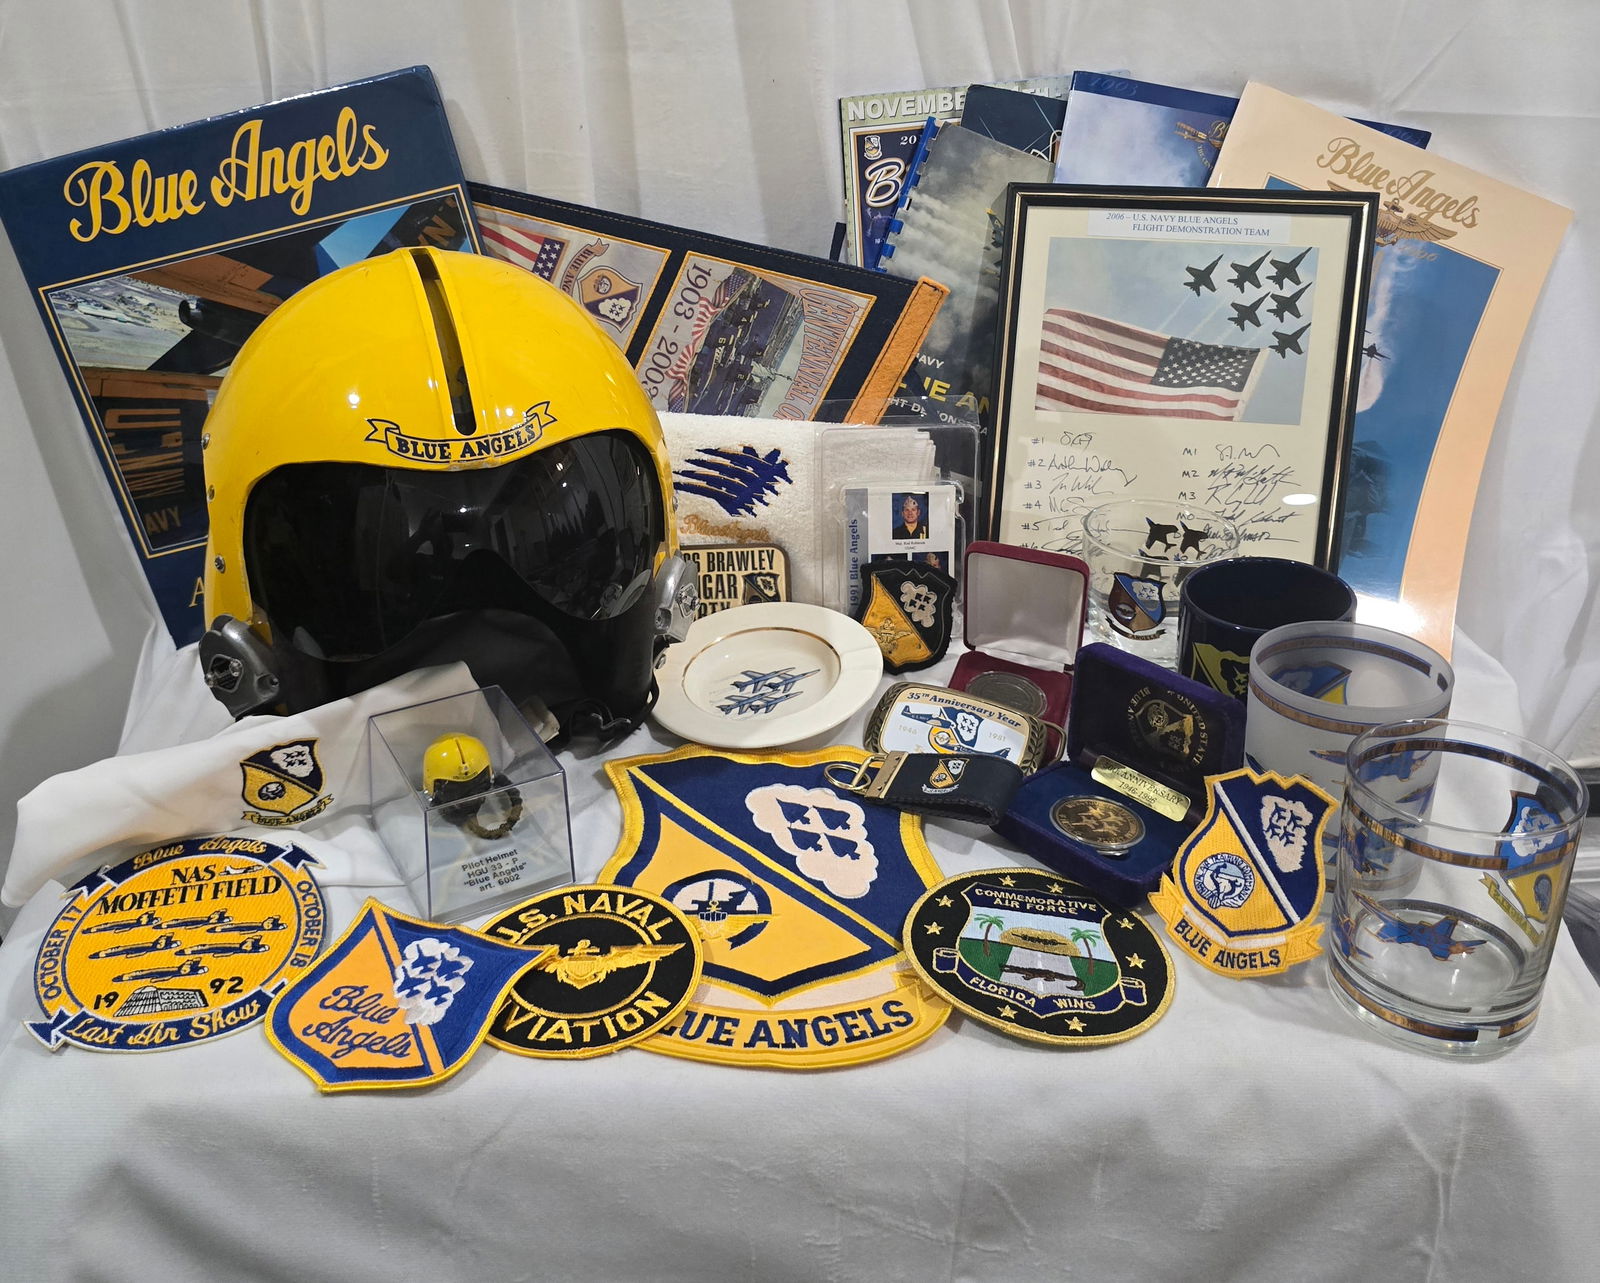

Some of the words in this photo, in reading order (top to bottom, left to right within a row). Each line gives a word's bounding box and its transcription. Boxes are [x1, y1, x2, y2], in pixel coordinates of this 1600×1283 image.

[64, 158, 206, 242] Blue
[211, 106, 389, 216] Angels
[1317, 137, 1391, 190] Blue
[1386, 170, 1480, 229] Angels
[1106, 212, 1125, 220] 2006
[1133, 213, 1148, 222] U.S.
[1150, 215, 1175, 223] NAVY
[1178, 216, 1201, 224] BLUE
[1203, 217, 1239, 225] ANGELS
[1132, 223, 1164, 232] FLIGHT
[1166, 225, 1243, 235] DEMONSTRATION
[1244, 228, 1270, 236] TEAM
[674, 263, 712, 320] 1903
[785, 288, 859, 405] CENTENNIAL
[917, 353, 945, 369] AVY
[395, 436, 452, 460] BLUE
[460, 423, 537, 458] ANGELS
[849, 519, 860, 554] Angels
[706, 549, 775, 573] BRAWLEY
[849, 556, 859, 581] Blue
[698, 573, 738, 600] GAR
[849, 585, 859, 607] 1991
[929, 694, 996, 718] Anniversary
[997, 711, 1022, 728] Year
[1119, 769, 1184, 806] ANNIVERSARY
[133, 843, 185, 870] Blue
[199, 835, 268, 854] Angels
[461, 860, 485, 872] Pilot
[485, 849, 518, 865] Helmet
[467, 867, 488, 879] HGU
[490, 862, 503, 872] 33
[511, 857, 518, 865] P
[171, 864, 217, 885] NAS
[479, 882, 495, 892] art.
[497, 873, 521, 886] 6002
[96, 883, 209, 916] MOFFETT
[212, 875, 283, 900] FIELD
[974, 887, 1098, 912] COMMEMORATIVE
[993, 897, 1020, 909] AIR
[1026, 901, 1079, 915] FORCE
[209, 914, 219, 923] 2
[296, 880, 322, 947] OCTOBER
[563, 892, 674, 941] NAVAL
[40, 928, 69, 1000] OCTOBER
[61, 905, 82, 921] 17
[157, 937, 166, 948] 3
[241, 939, 252, 951] 4
[1174, 917, 1212, 957] BLUE
[1213, 948, 1282, 969] ANGELS
[289, 952, 311, 968] 18
[94, 990, 120, 1010] 19
[209, 976, 244, 995] 92
[319, 985, 400, 1025] Blue
[969, 976, 1036, 1008] FLORIDA
[1053, 999, 1096, 1010] WING
[67, 1016, 124, 1045] Last
[128, 1022, 181, 1046] Air
[189, 999, 261, 1039] Show
[497, 991, 672, 1044] VIATION
[743, 1000, 915, 1049] ANGELS
[302, 1015, 412, 1059] Angels
